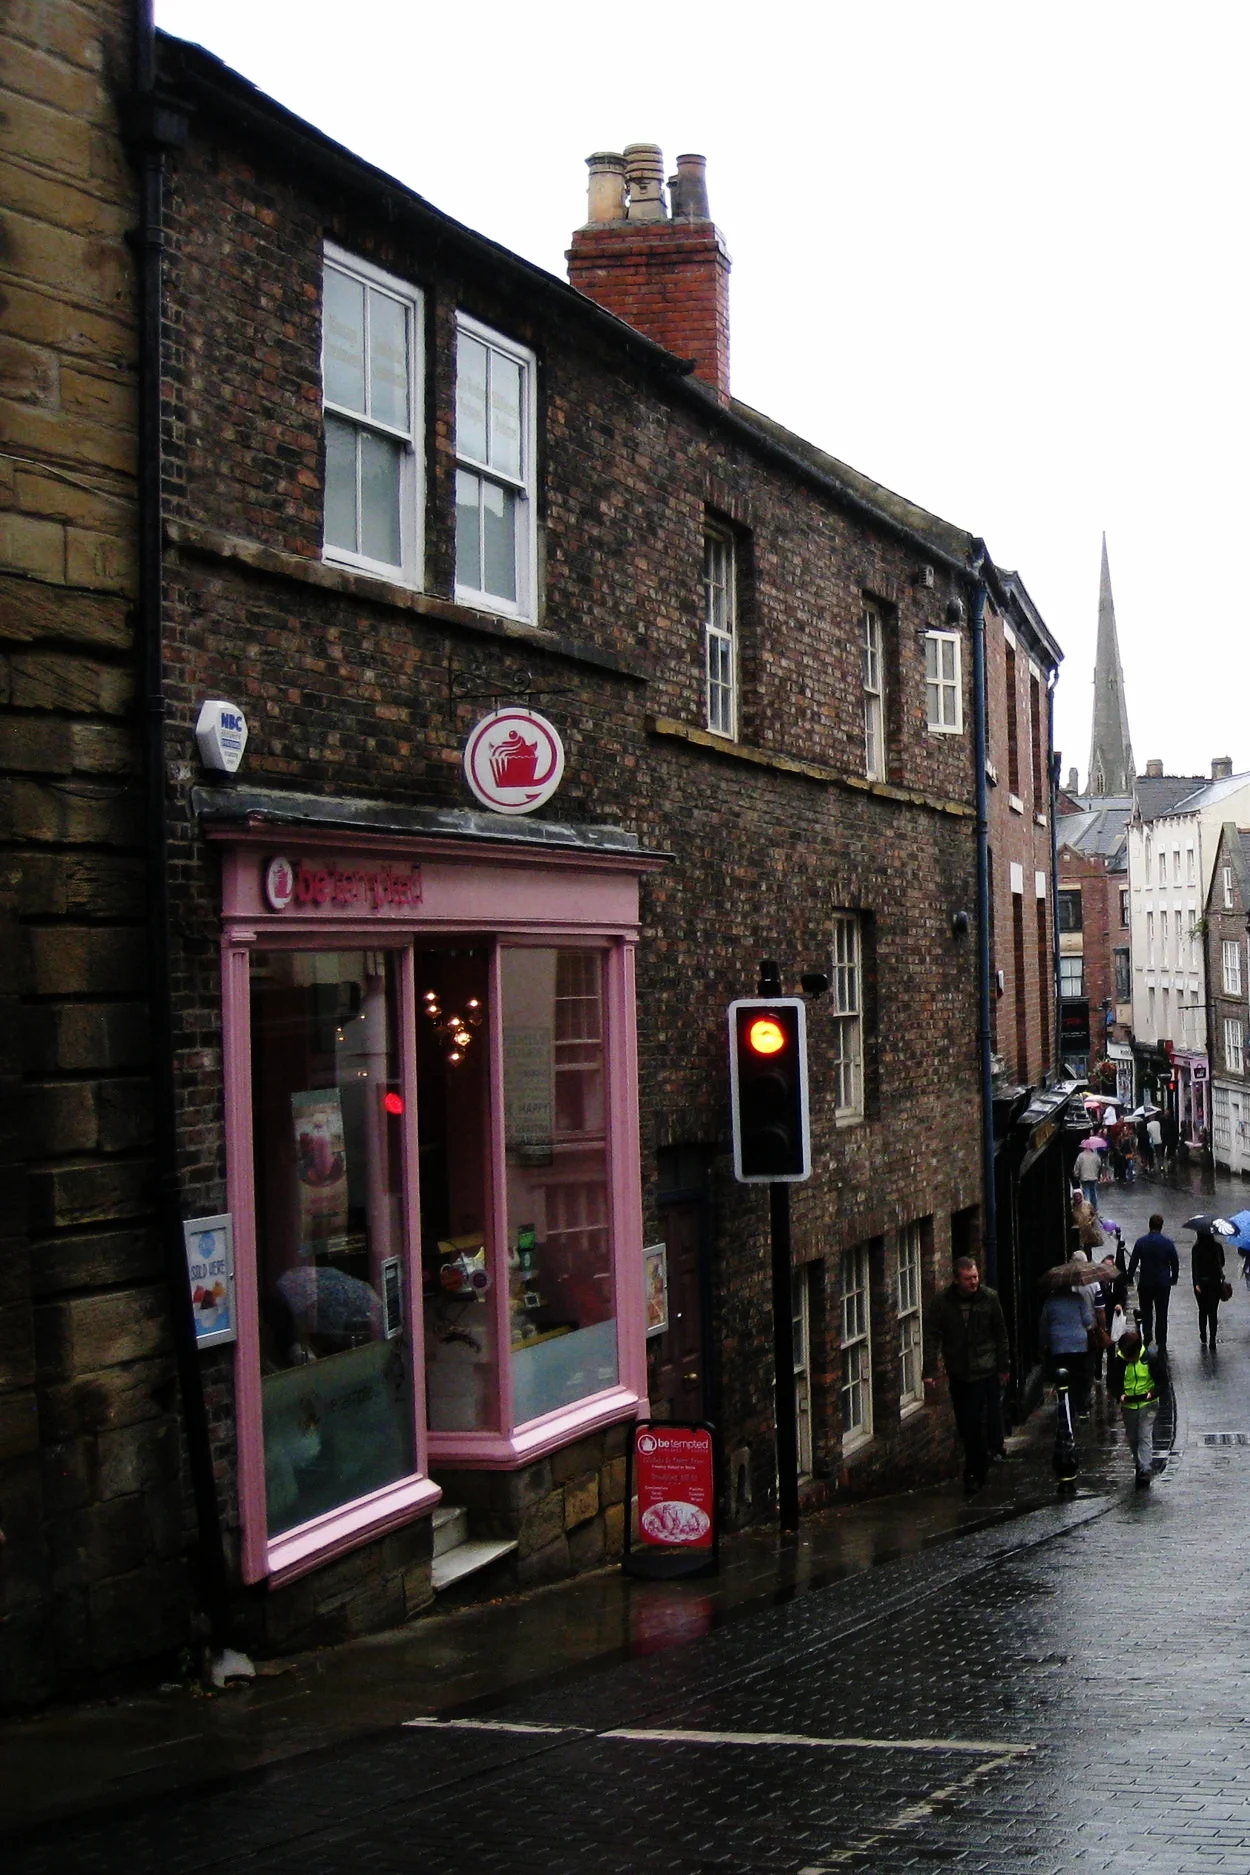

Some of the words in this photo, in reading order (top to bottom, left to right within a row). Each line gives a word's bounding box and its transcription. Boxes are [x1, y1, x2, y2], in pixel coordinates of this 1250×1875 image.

[221, 712, 243, 732] NBC
[191, 1264, 208, 1281] SOLD
[658, 1438, 669, 1449] be
[670, 1440, 709, 1450] tempted
